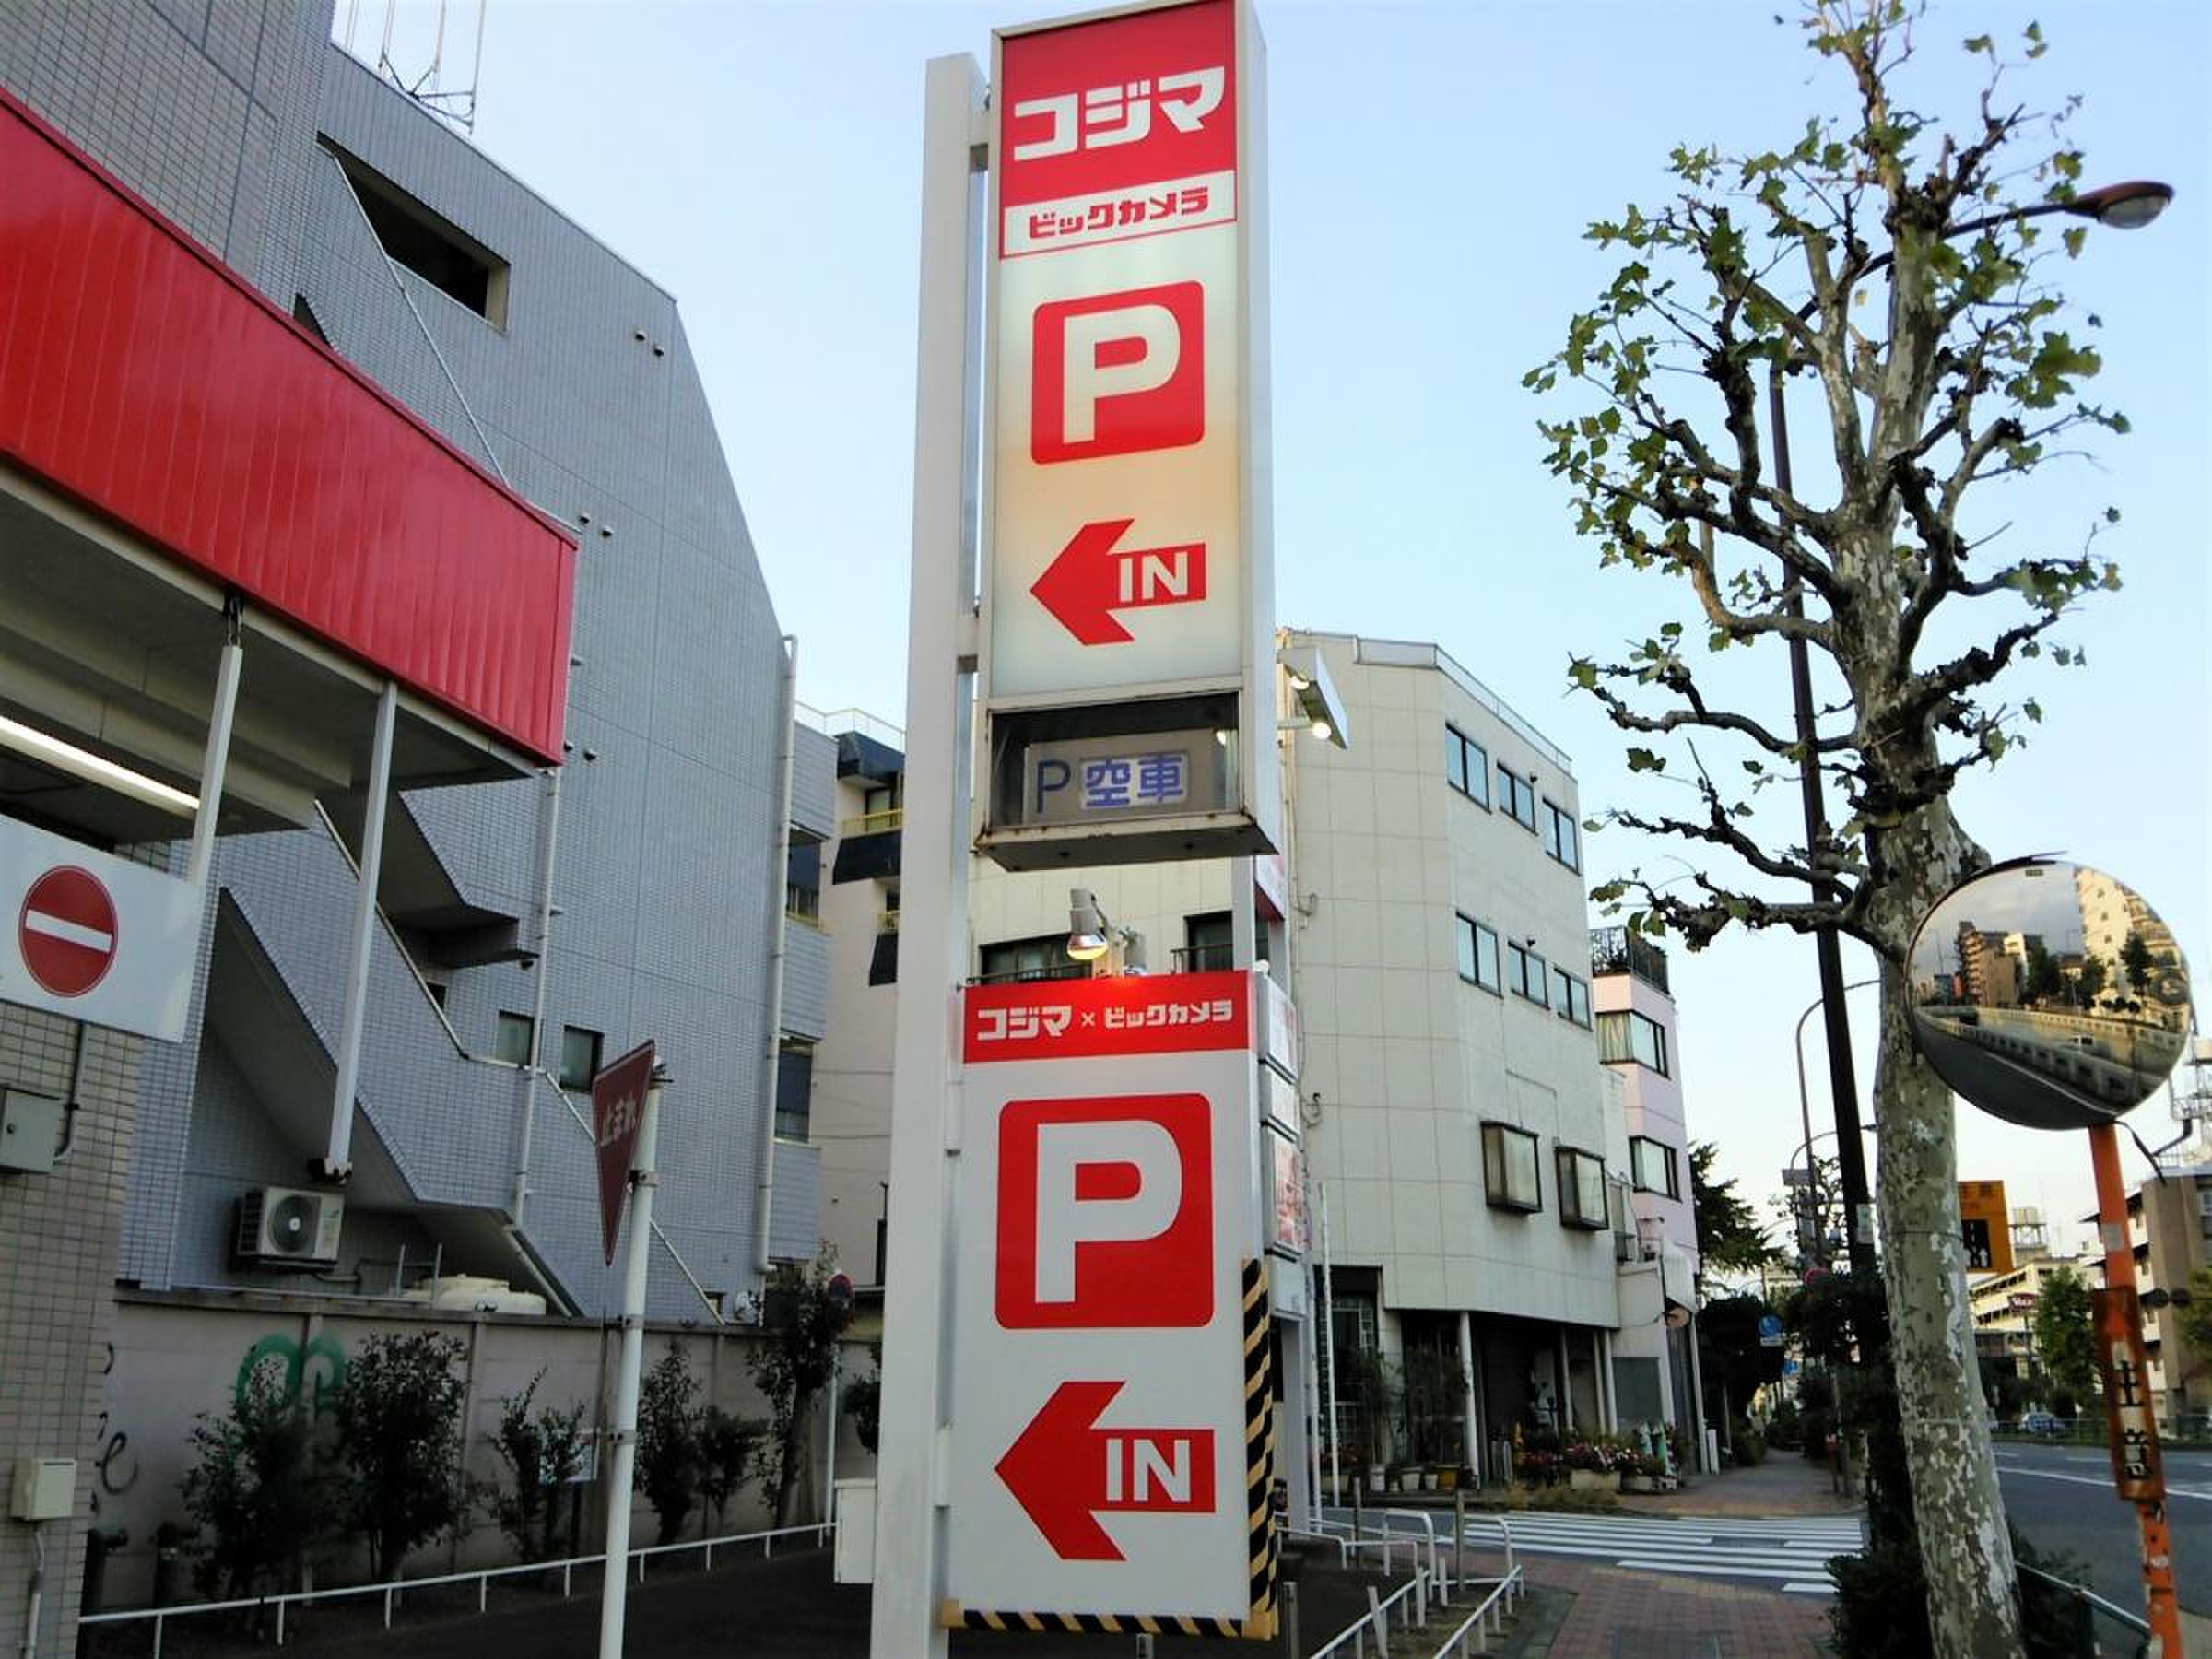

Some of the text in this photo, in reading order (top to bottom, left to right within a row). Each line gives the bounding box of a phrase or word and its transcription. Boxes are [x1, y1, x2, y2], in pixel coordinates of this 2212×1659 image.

[1014, 66, 1225, 161] コジマ
[1029, 186, 1209, 240] ビックカメラ
[1063, 303, 1181, 445] P
[1118, 551, 1188, 603] IN
[1036, 753, 1183, 814] P 空車
[977, 1005, 1073, 1041] コジマ
[1104, 998, 1233, 1029] ビックカメラ
[1034, 1119, 1182, 1304] P
[1106, 1438, 1191, 1502] IN
